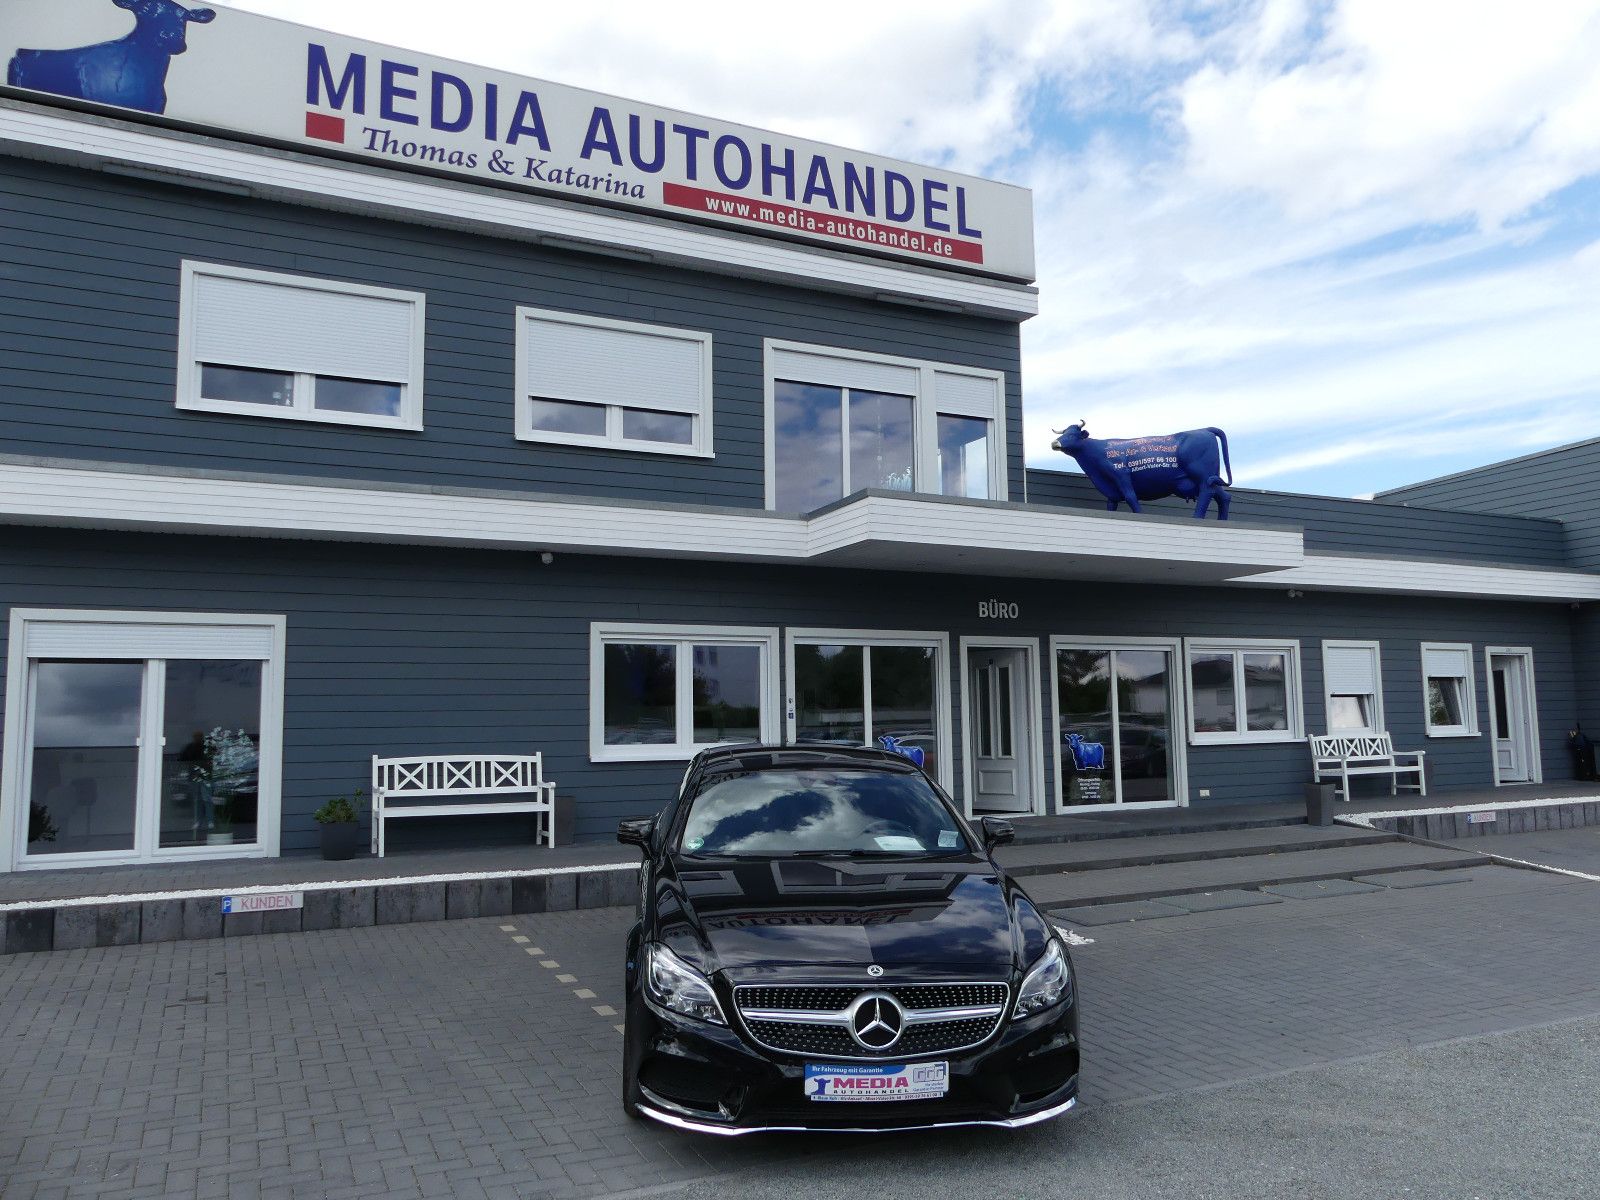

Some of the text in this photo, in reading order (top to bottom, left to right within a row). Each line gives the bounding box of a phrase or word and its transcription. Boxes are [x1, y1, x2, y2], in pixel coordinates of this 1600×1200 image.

[306, 42, 982, 239] MEDIA AUTOHANDEL
[362, 126, 646, 199] Thomas & Katarina
[705, 196, 953, 257] www.media-autohandel.de
[979, 598, 1019, 619] BÜRO
[223, 895, 293, 910] P KUNDEN
[821, 1066, 847, 1075] Fahrzeug
[833, 1077, 909, 1089] MEDIA
